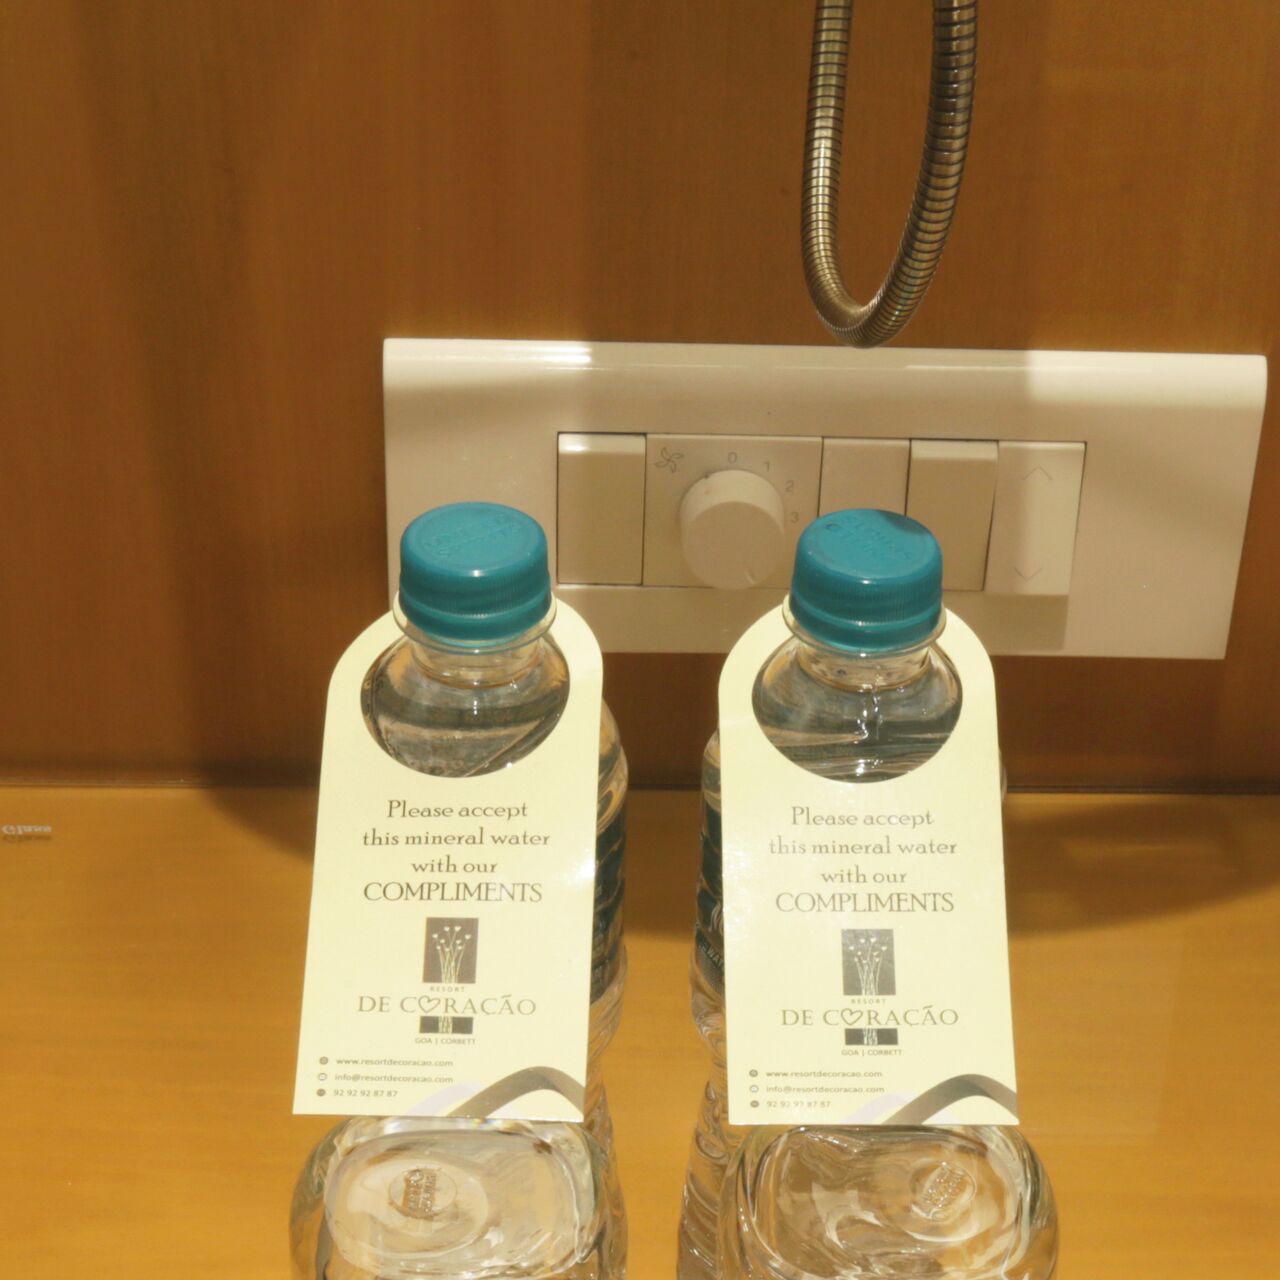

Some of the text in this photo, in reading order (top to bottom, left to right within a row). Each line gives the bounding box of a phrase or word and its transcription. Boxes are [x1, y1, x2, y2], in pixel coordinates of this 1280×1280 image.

[728, 452, 738, 464] 0
[764, 461, 771, 473] 1
[785, 480, 794, 493] 2
[790, 512, 800, 524] 3
[387, 799, 528, 821] Please accept
[791, 806, 934, 829] Please accept
[363, 827, 551, 846] this mineral water
[770, 834, 957, 854] this mineral water
[411, 854, 498, 873] with our
[820, 864, 907, 883] with our
[363, 881, 543, 903] COMPLIMENTS
[776, 892, 955, 913] COMPLIMENTS
[357, 995, 390, 1013] DE
[781, 1009, 814, 1026] DE
[336, 1057, 454, 1067] www.resortdecoracao.com
[334, 1073, 454, 1083] info@resortdecoracao.com
[765, 1070, 883, 1078] www.resortdecoracao.com
[766, 1085, 885, 1094] info@resortdecoracao.com
